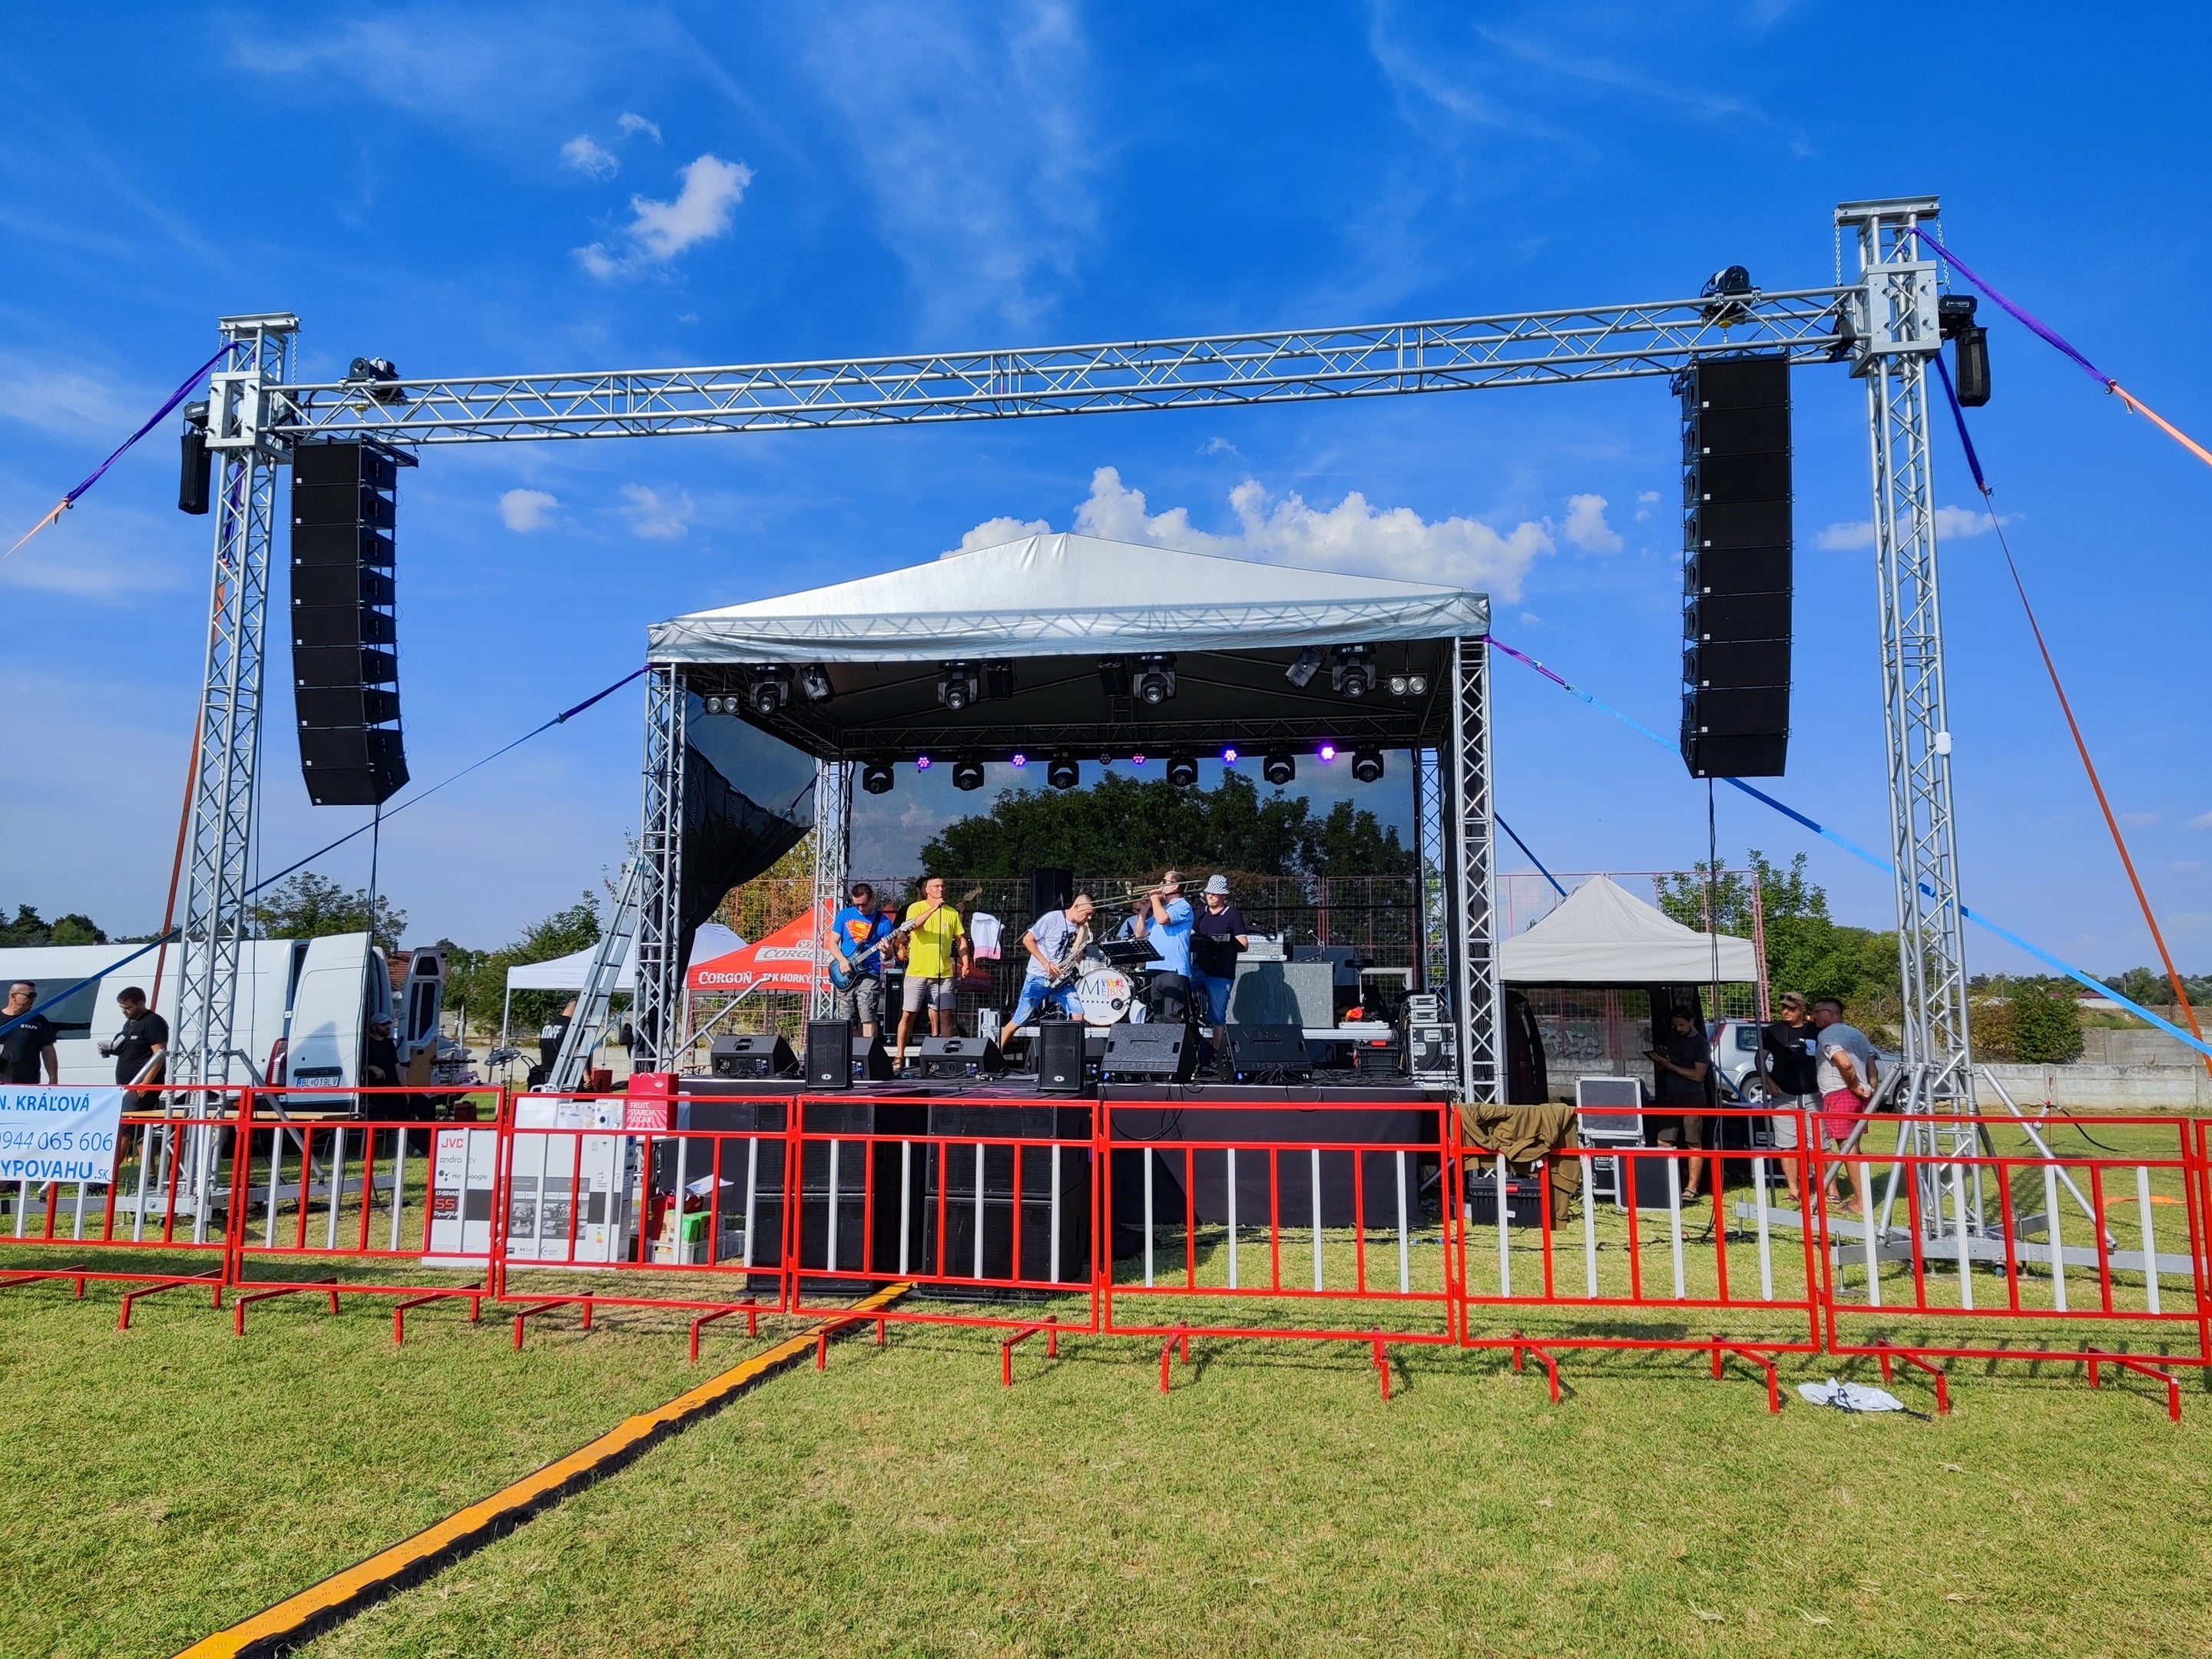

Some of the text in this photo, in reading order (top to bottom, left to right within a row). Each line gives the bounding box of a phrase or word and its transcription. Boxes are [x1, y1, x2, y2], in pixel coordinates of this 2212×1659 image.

[698, 970, 752, 984] CORGOŇ
[16, 1093, 90, 1111] KRÁĽOVÁ
[0, 1131, 113, 1151] 944 065 606
[441, 1138, 463, 1148] JVC
[439, 1155, 464, 1164] andro
